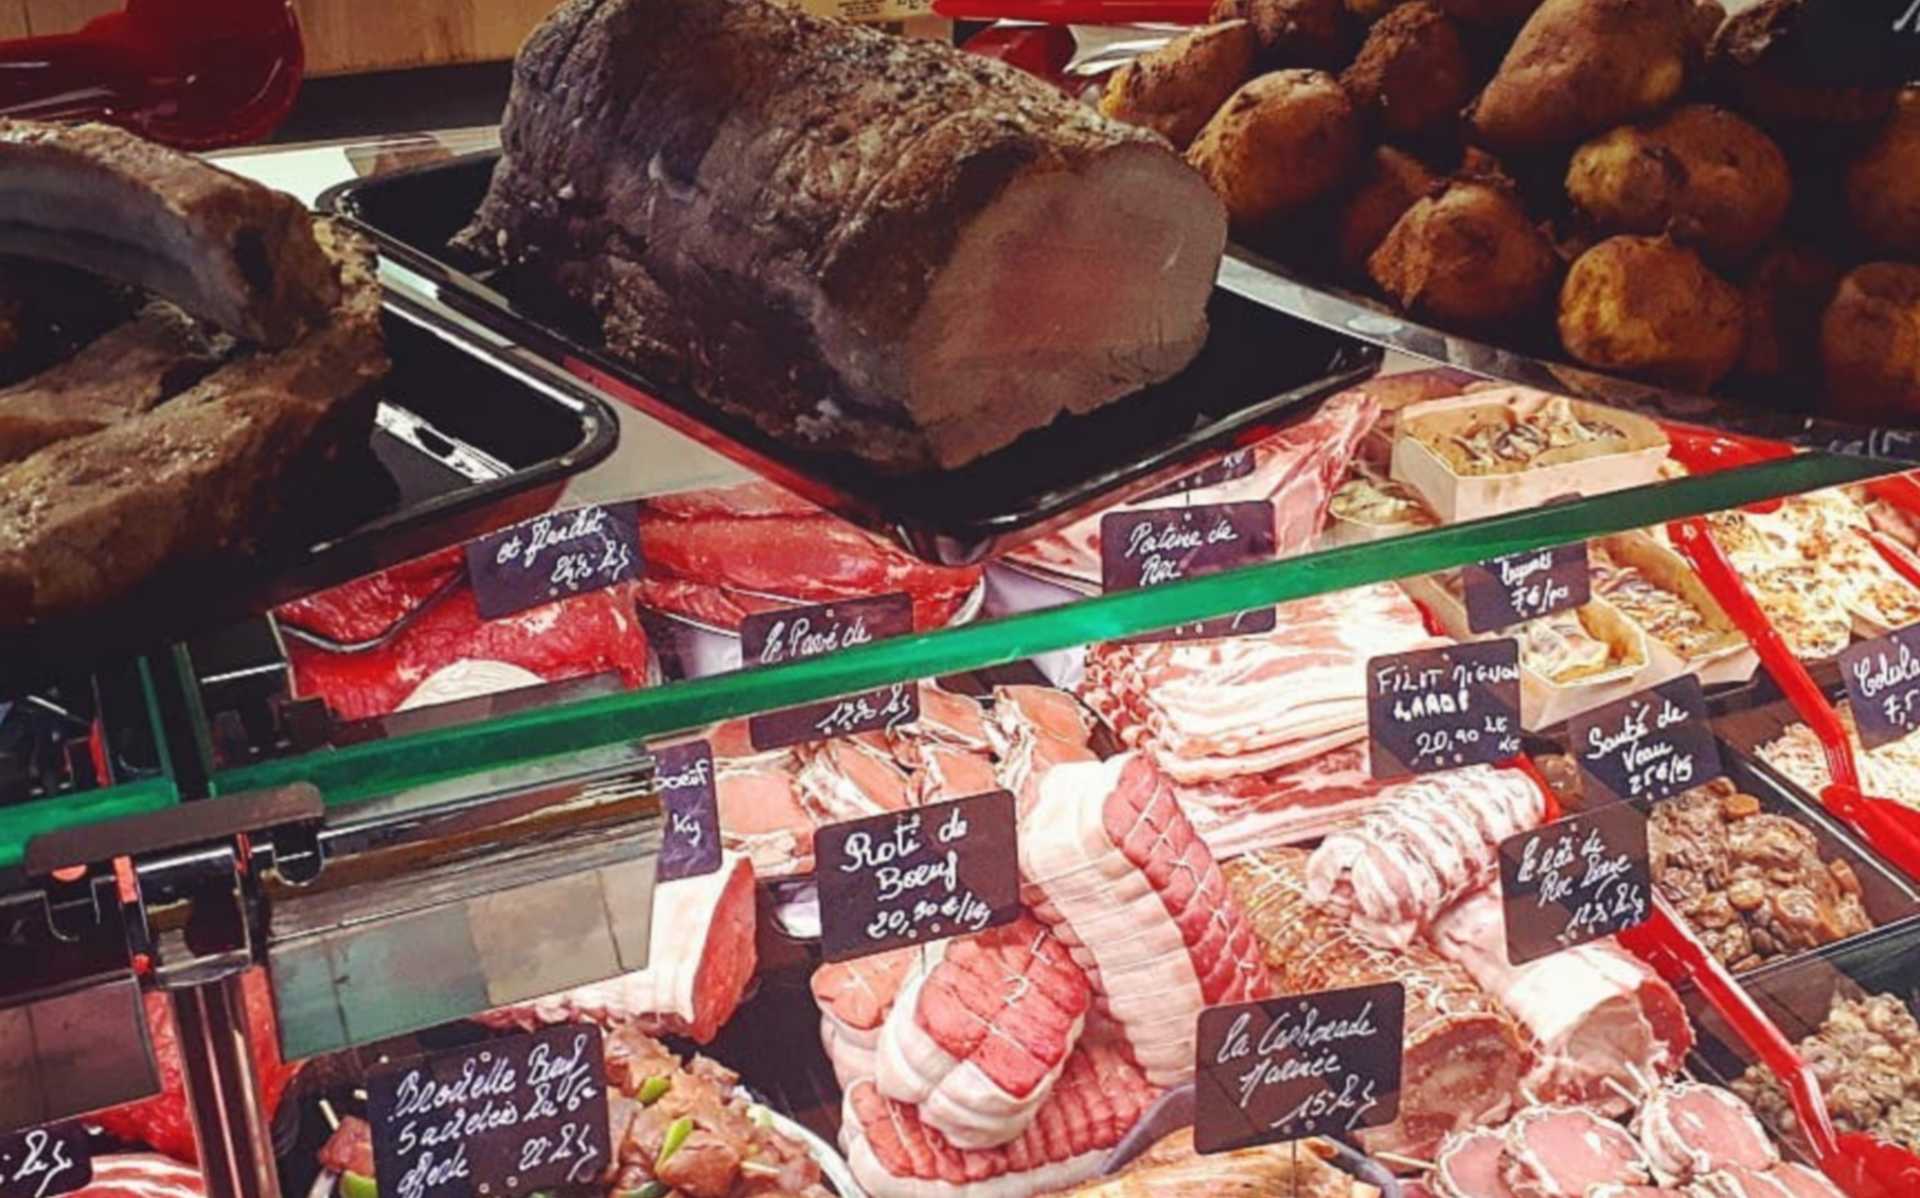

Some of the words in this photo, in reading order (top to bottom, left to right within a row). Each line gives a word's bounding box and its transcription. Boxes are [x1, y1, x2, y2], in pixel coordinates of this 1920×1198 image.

[1208, 519, 1238, 545] de
[788, 617, 840, 657] Pavé
[842, 615, 872, 648] de
[1586, 703, 1651, 760] Sauté
[1657, 699, 1689, 729] de
[1622, 741, 1674, 772] Veau
[938, 807, 968, 843] de
